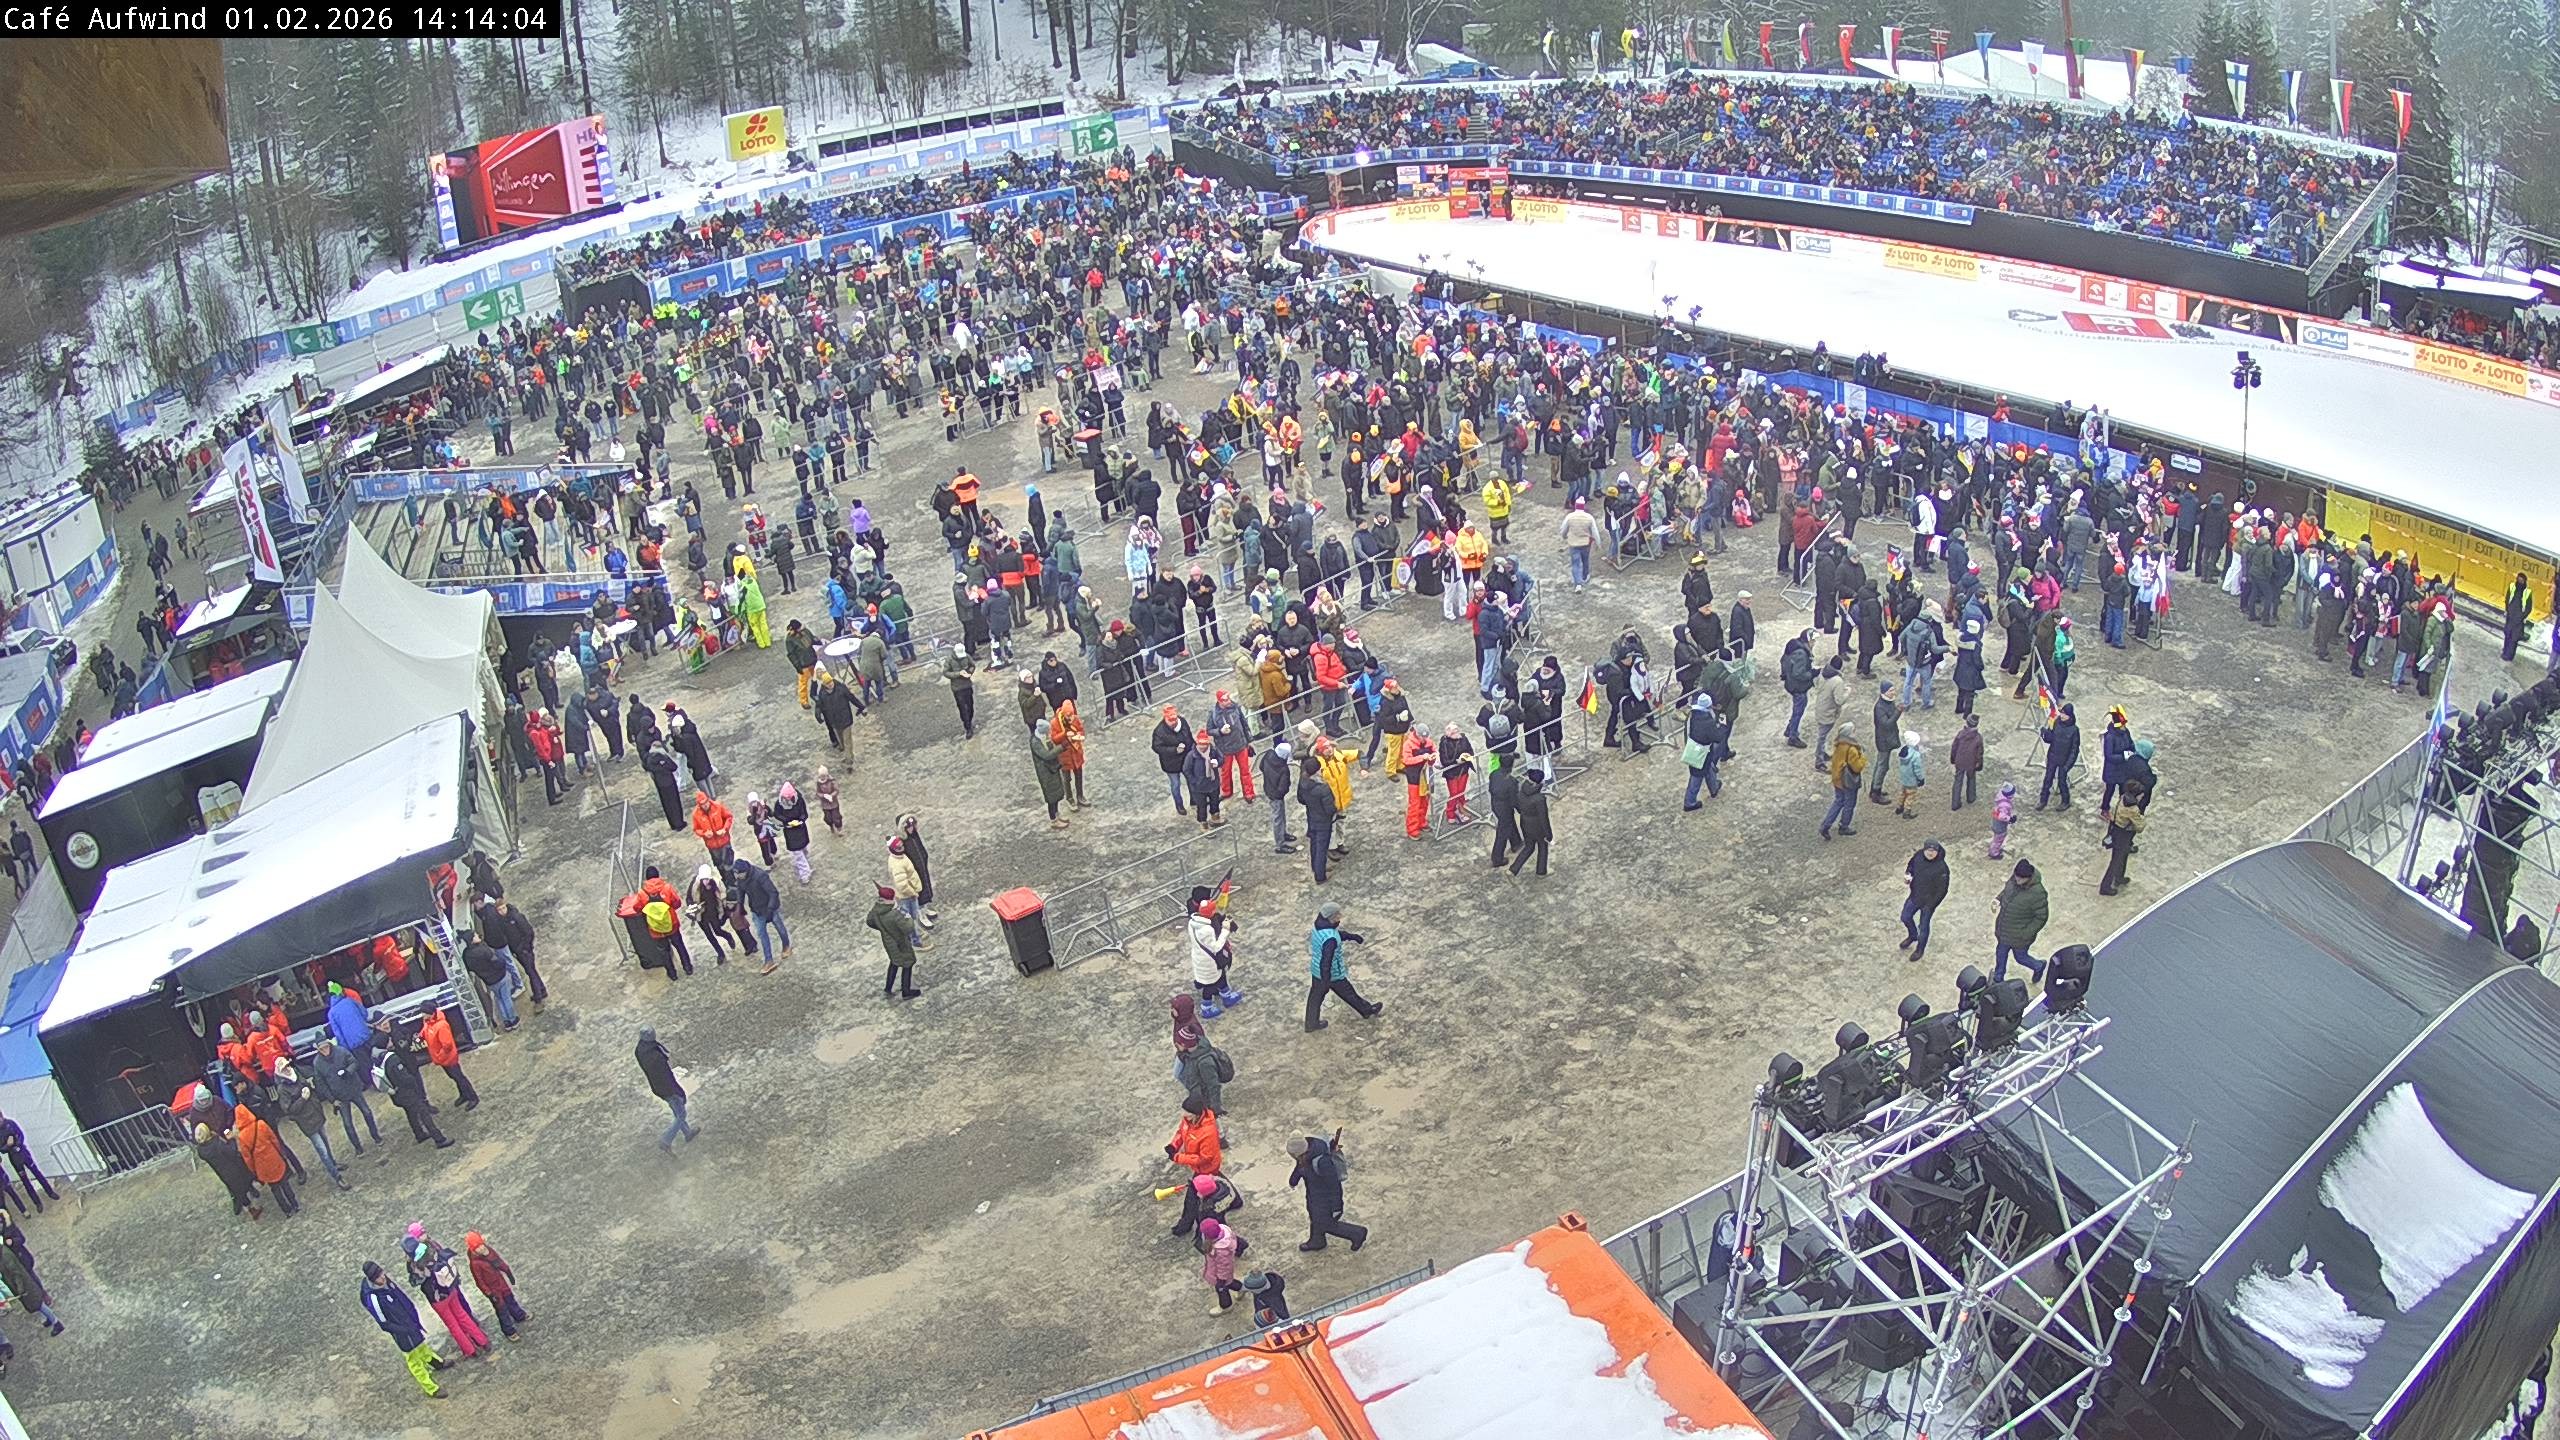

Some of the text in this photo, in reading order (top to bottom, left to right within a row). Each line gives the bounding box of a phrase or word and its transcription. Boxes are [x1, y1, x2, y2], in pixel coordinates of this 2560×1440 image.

[740, 134, 776, 151] LOTTO
[1408, 204, 1440, 214] LOTTO
[1530, 202, 1558, 213] LOTTO
[1898, 250, 1975, 270] LOTTO LOTTO
[2322, 332, 2348, 344] PLAN
[2432, 352, 2524, 384] LOTTO LOTTO
[2384, 511, 2540, 575] EXIT EXIT EXIT EXIT
